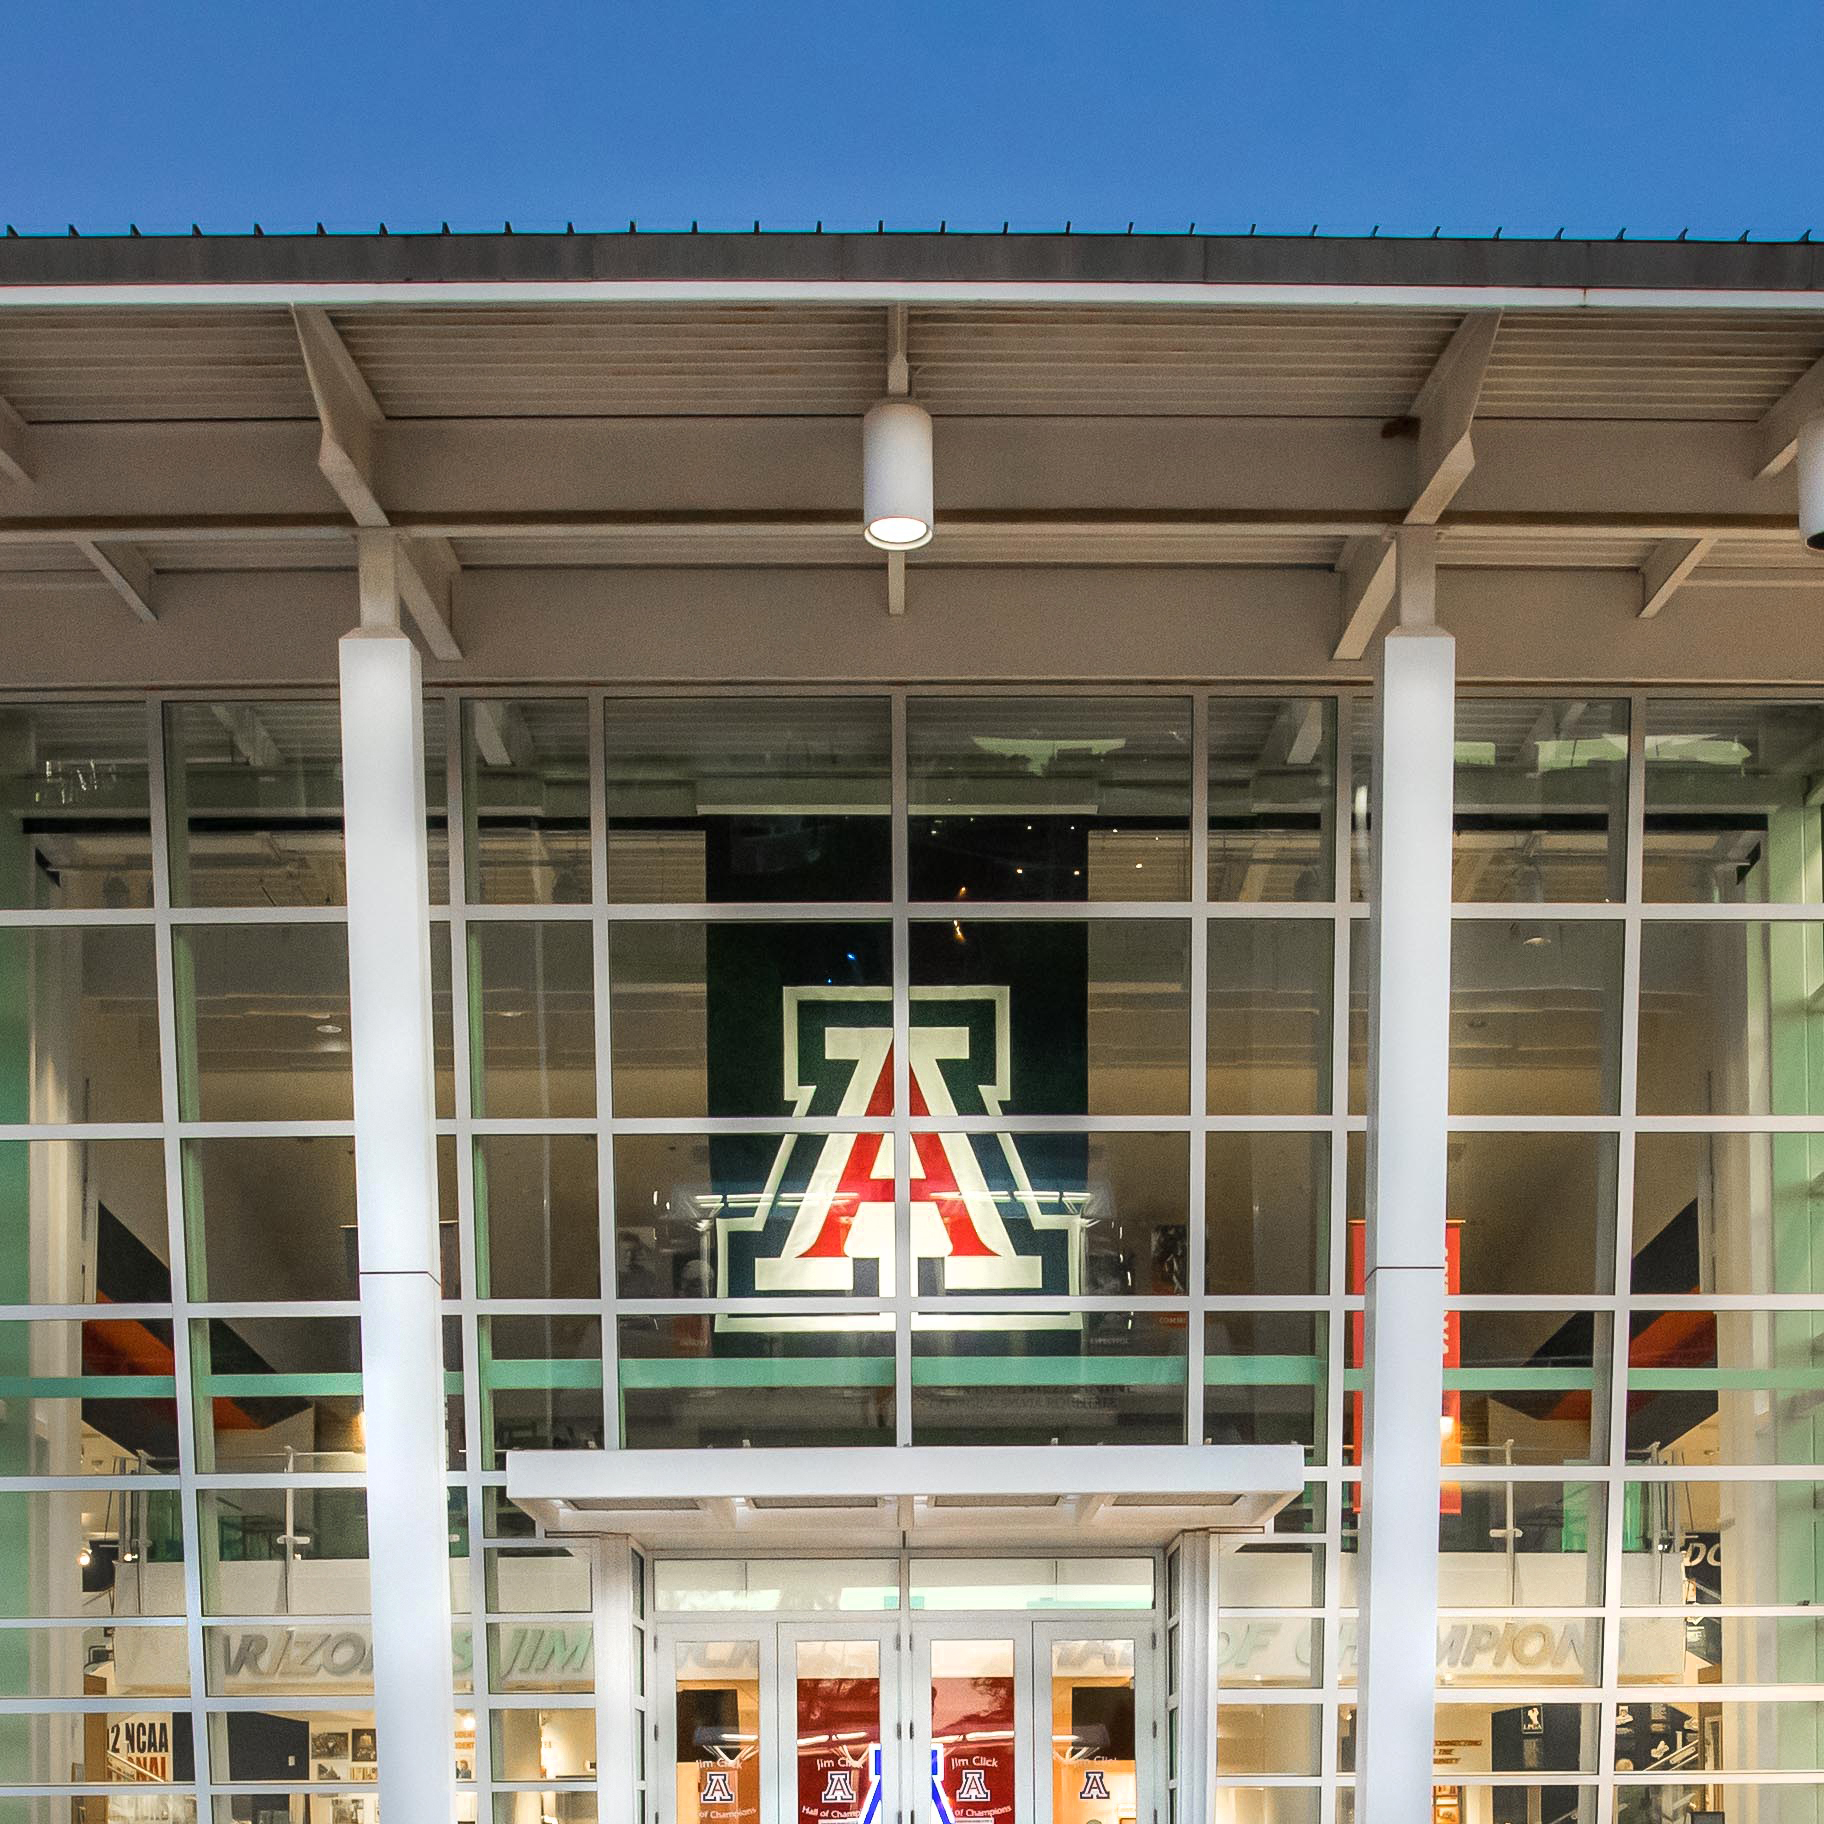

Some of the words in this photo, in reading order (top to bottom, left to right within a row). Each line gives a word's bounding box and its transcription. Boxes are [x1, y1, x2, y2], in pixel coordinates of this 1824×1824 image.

[715, 985, 1084, 1333] A
[125, 1722, 169, 1753] NCAA
[817, 1758, 834, 1771] Jim
[951, 1756, 969, 1770] Jim
[972, 1755, 999, 1768] Click
[701, 1771, 734, 1803] A
[822, 1771, 856, 1803] A
[956, 1770, 991, 1802] A
[1079, 1770, 1110, 1799] A
[802, 1805, 818, 1817] Hall
[820, 1809, 830, 1818] of
[955, 1807, 964, 1817] of
[966, 1804, 1013, 1817] Champions
